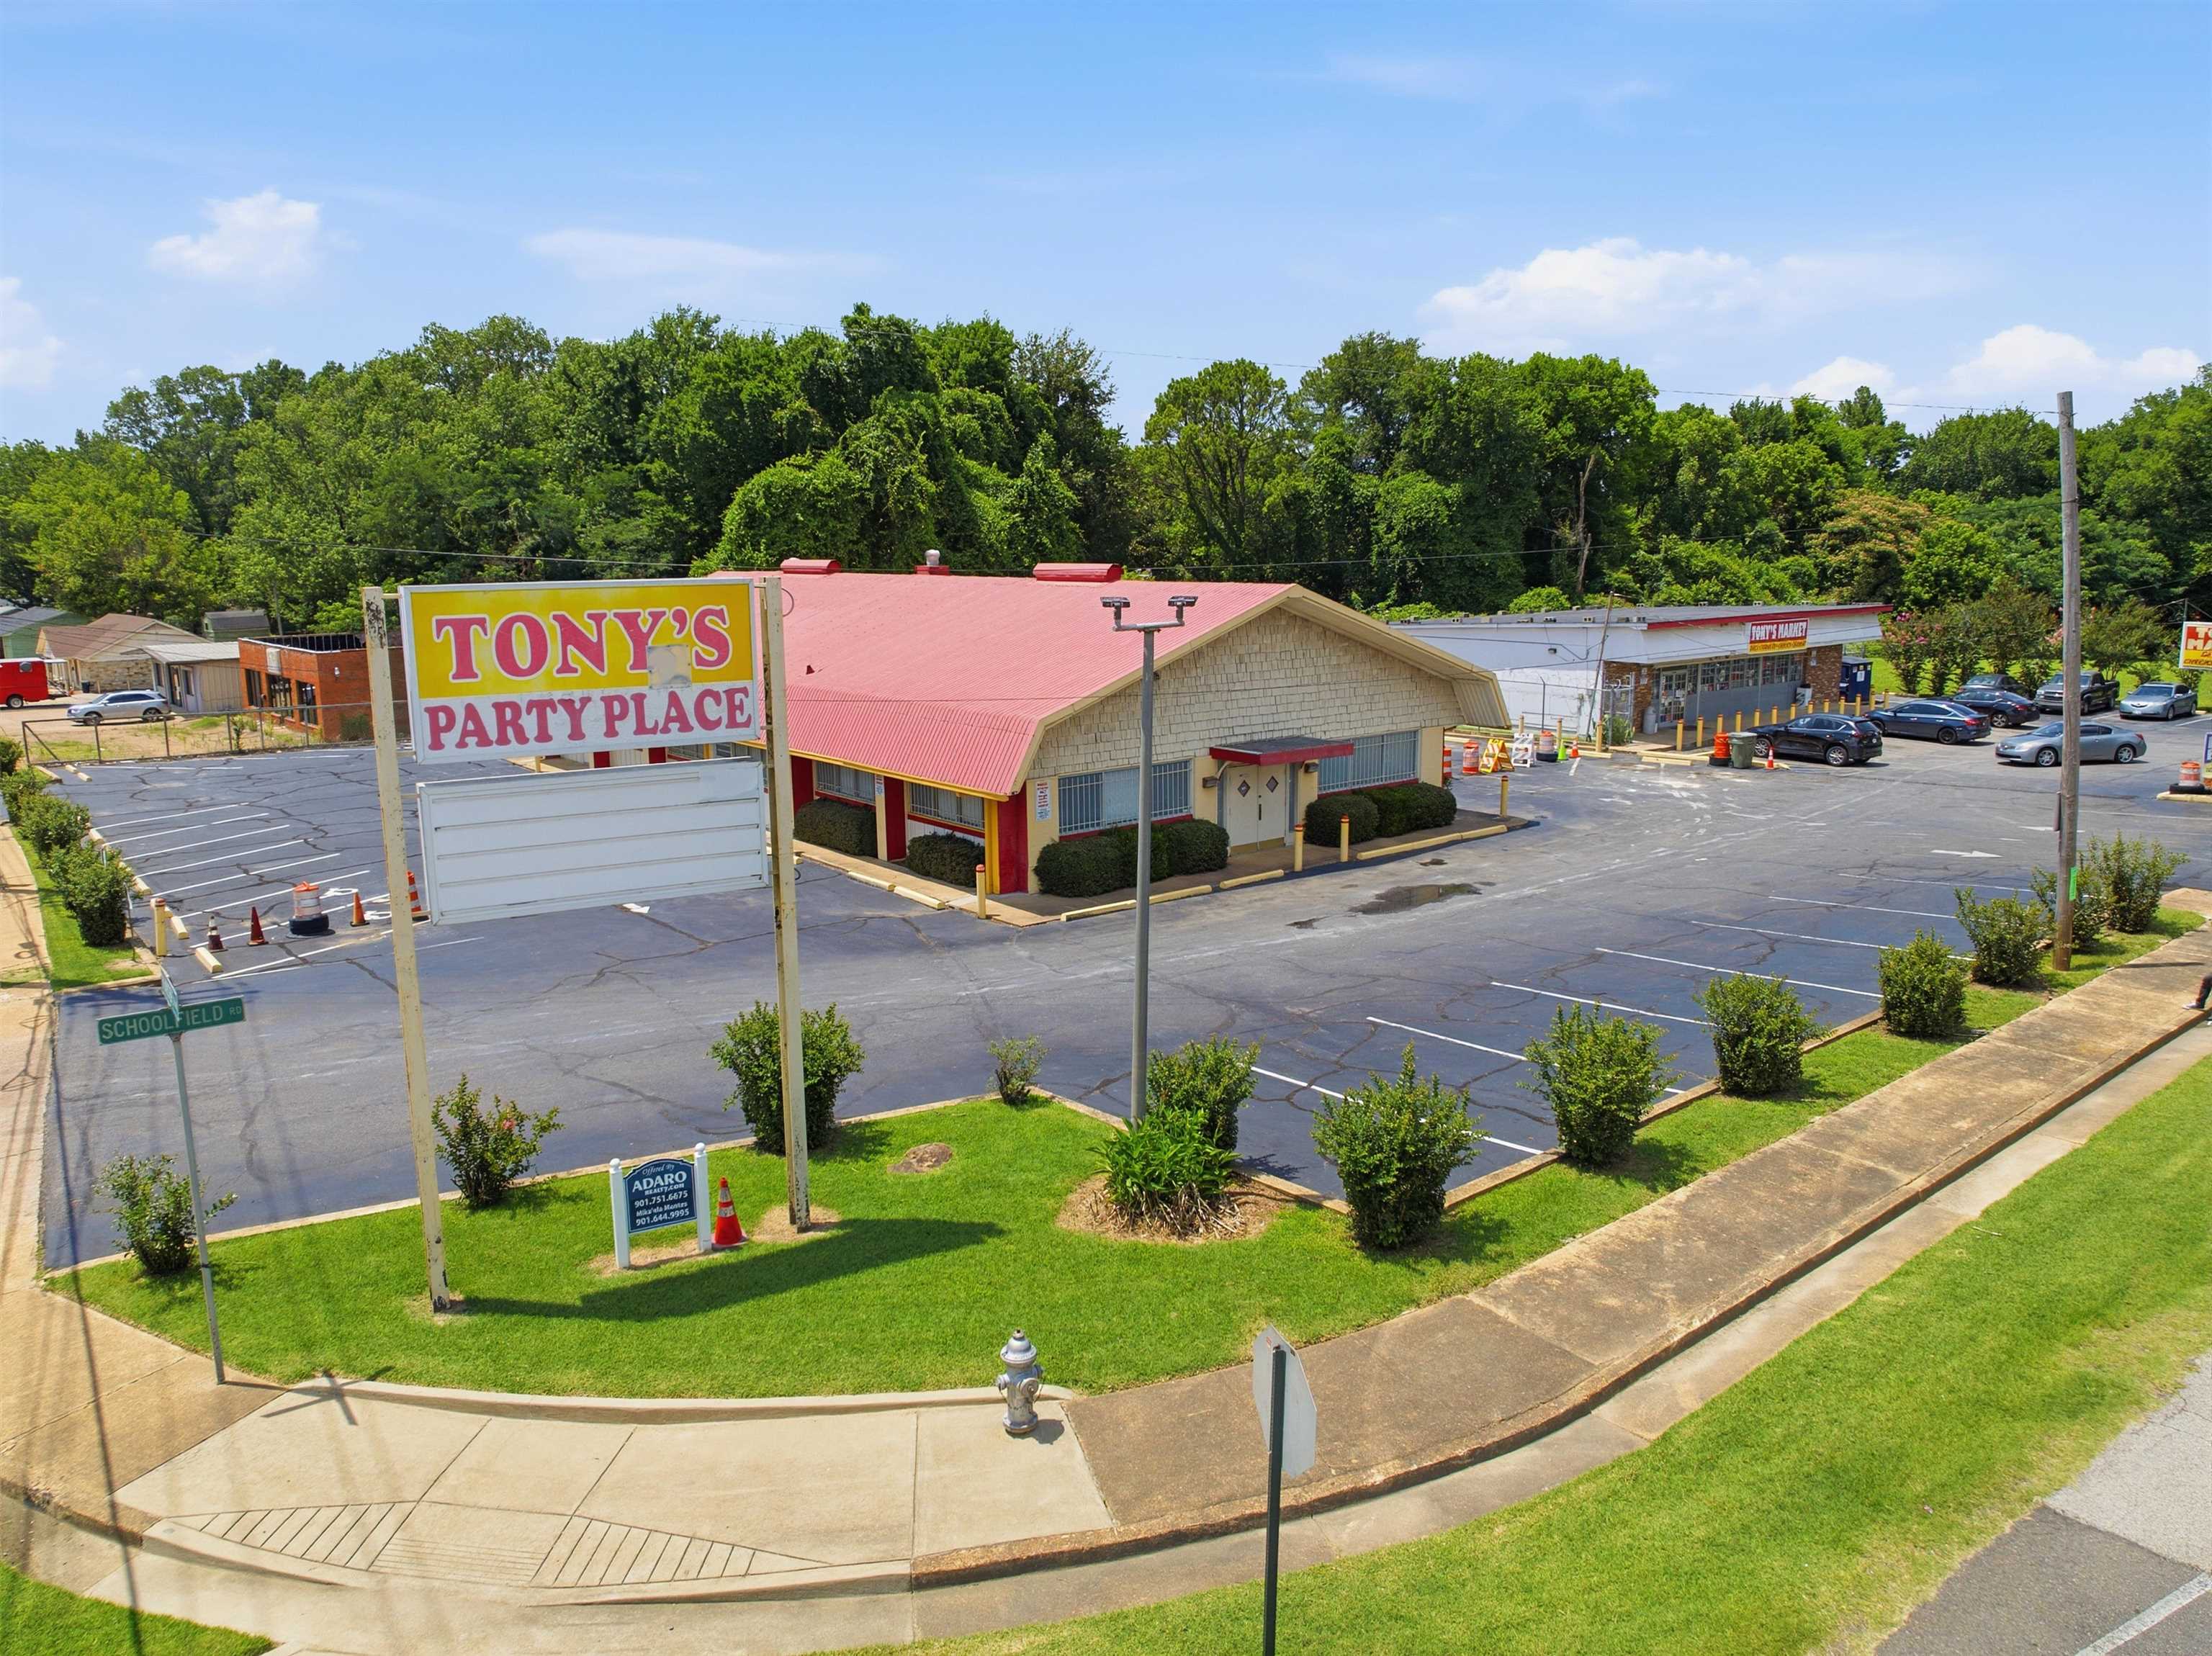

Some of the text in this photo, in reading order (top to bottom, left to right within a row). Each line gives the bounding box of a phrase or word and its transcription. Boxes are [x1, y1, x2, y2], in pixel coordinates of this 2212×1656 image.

[1751, 622, 1807, 640] TONY'S MARKET
[432, 606, 732, 682] TONY'S
[423, 686, 752, 750] PARTY PLACE
[230, 1006, 241, 1016] RD
[632, 1171, 687, 1192] ADARO
